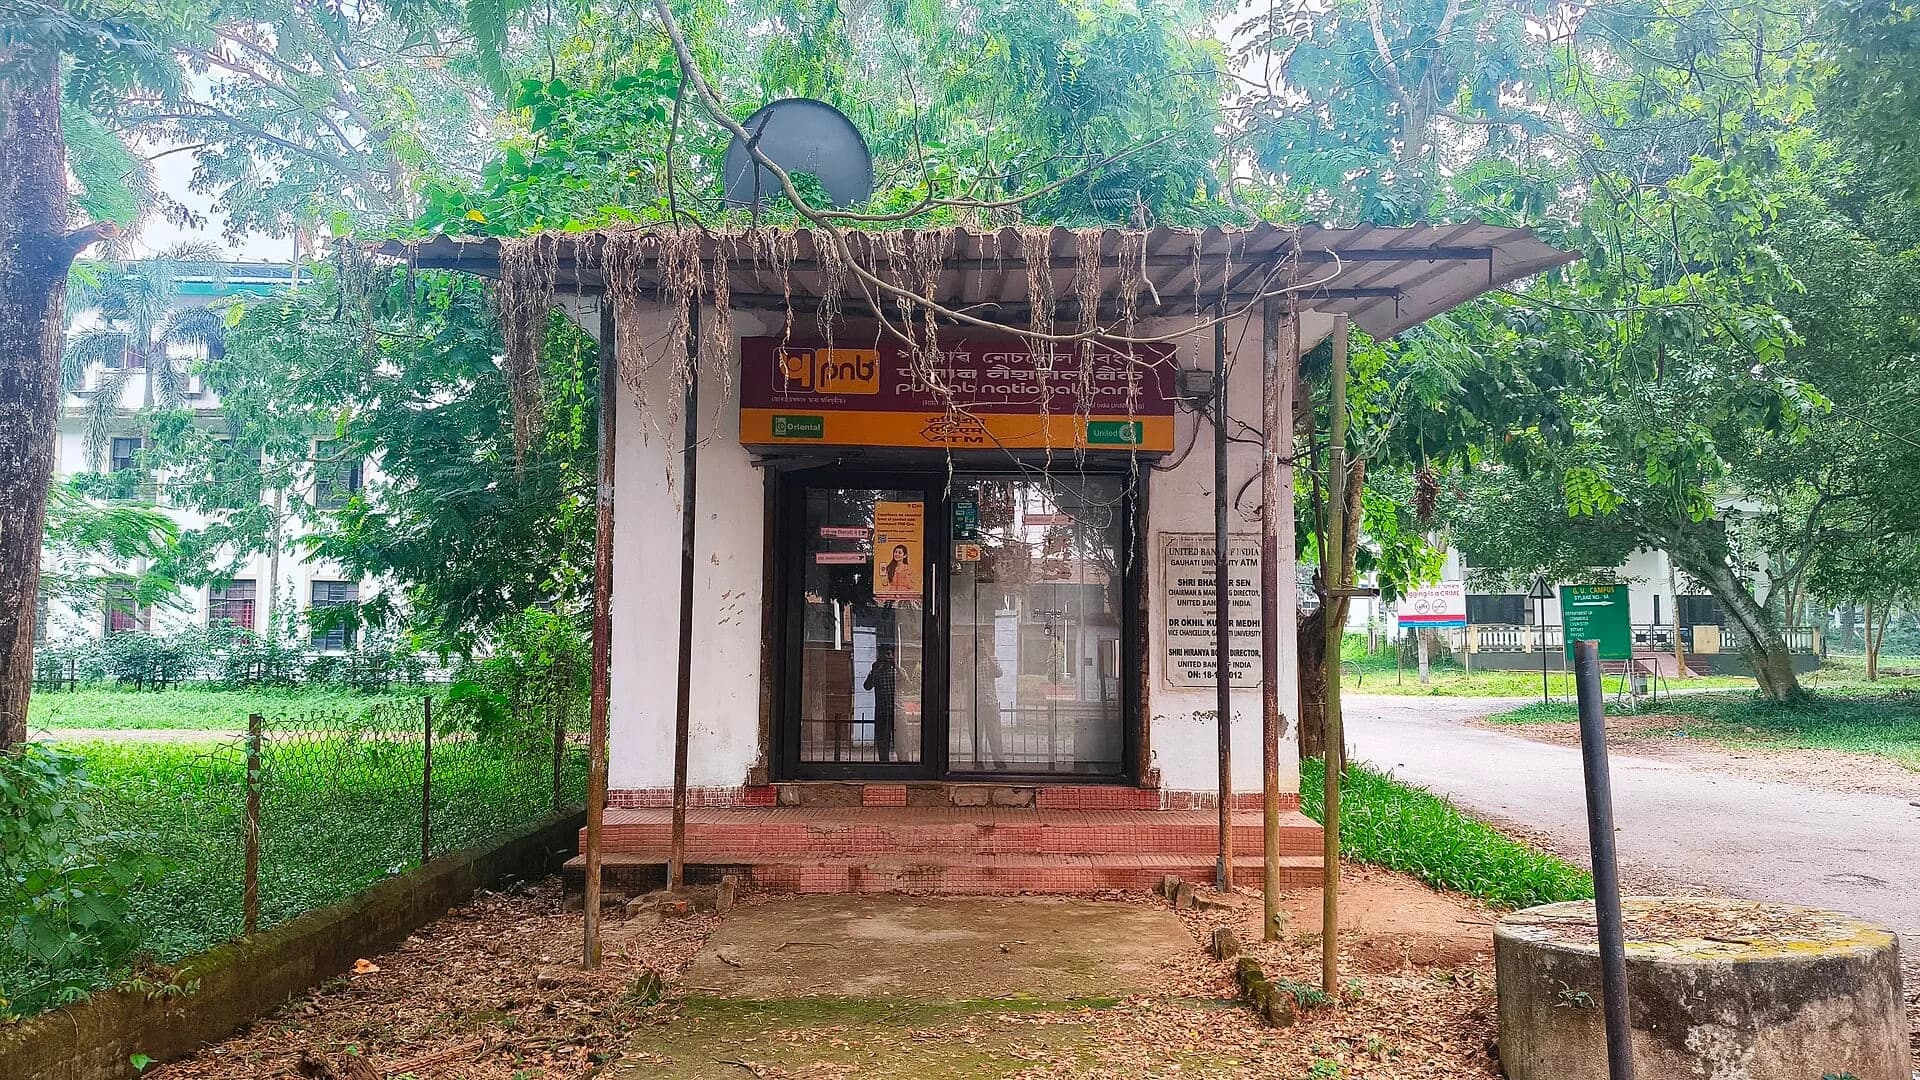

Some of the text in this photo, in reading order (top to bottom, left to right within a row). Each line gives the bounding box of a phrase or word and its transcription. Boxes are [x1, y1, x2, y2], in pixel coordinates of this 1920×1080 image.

[820, 354, 874, 387] pnb
[1169, 548, 1198, 556] UNITED
[1200, 548, 1217, 556] BAN
[1240, 558, 1258, 566] ATM
[1177, 579, 1251, 587] SHRI BHASR SEN
[1589, 586, 1615, 594] CAMPUS
[1207, 619, 1234, 627] KUR
[1236, 619, 1260, 628] MEDHI
[1179, 629, 1211, 638] CHANCELLOR,
[1230, 650, 1261, 658] DIRECTOR,
[1187, 671, 1201, 679] ON:
